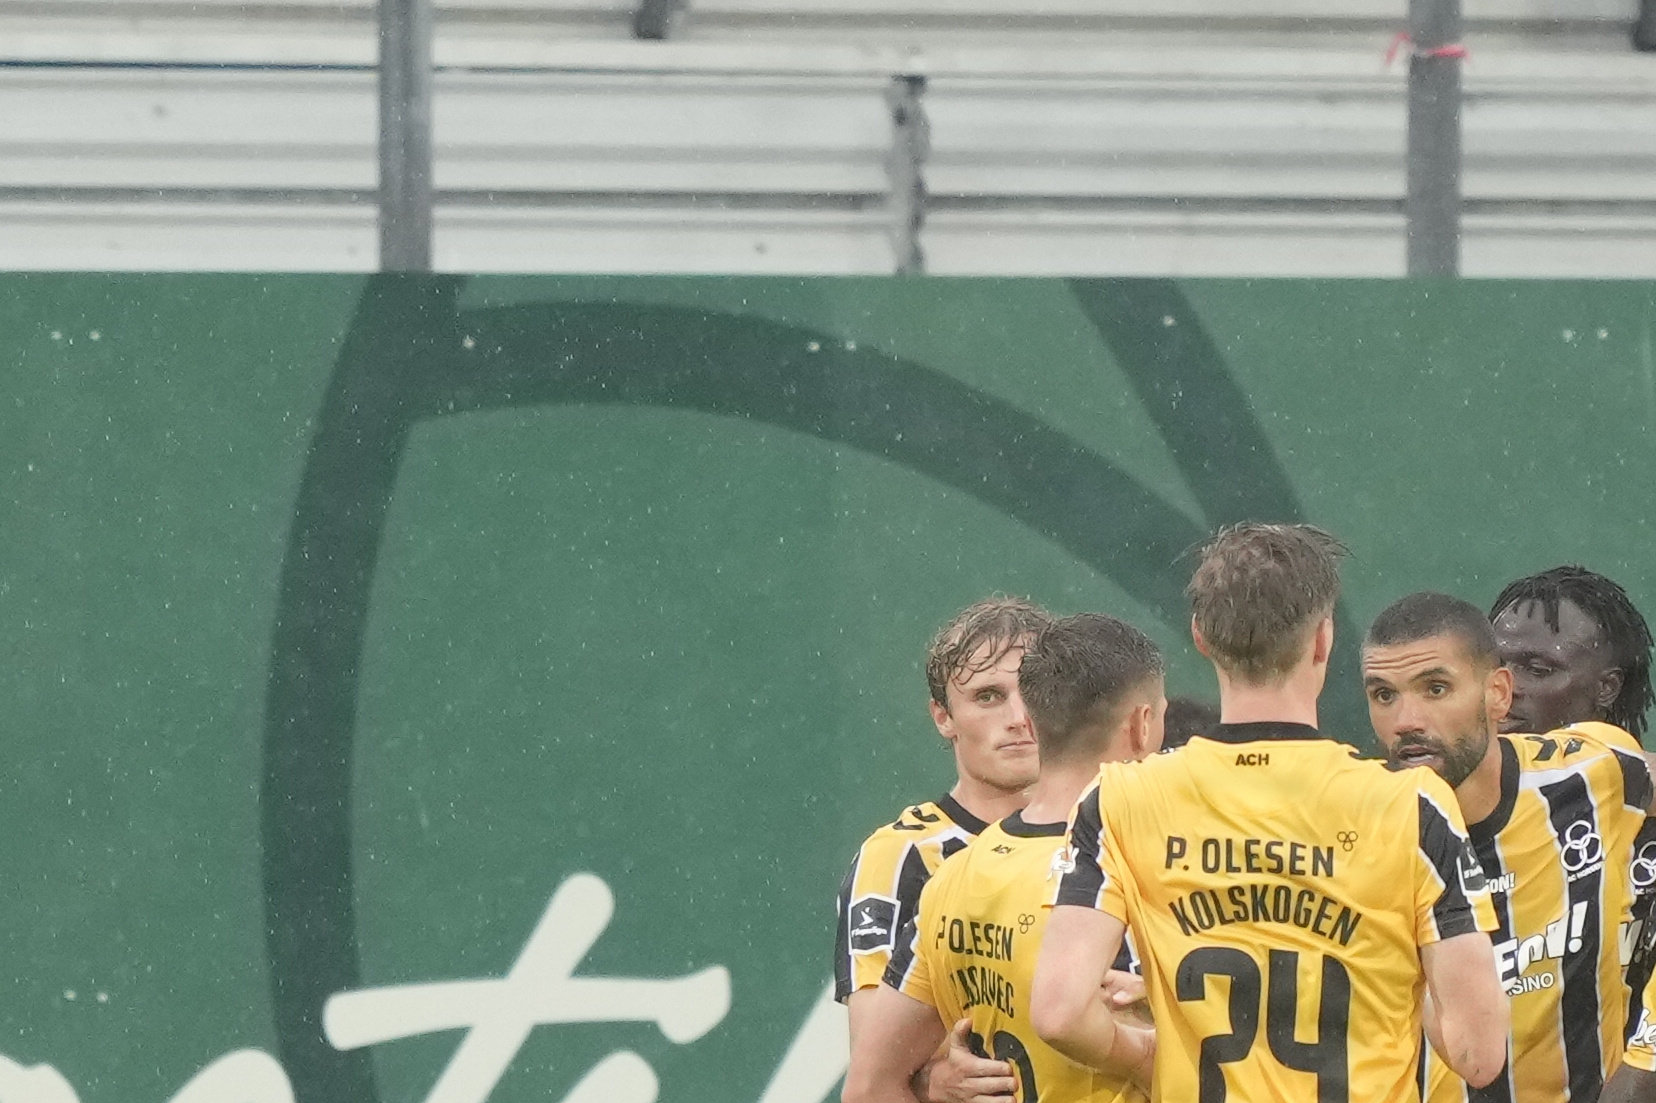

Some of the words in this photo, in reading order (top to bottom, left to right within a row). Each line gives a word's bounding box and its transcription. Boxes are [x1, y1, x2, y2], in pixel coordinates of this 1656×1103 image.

[1235, 753, 1270, 766] ACH
[1164, 835, 1190, 870] P.
[1201, 838, 1334, 877] OLESEN
[1168, 884, 1362, 946] KOLSKOGEN
[1506, 971, 1554, 996] SINO
